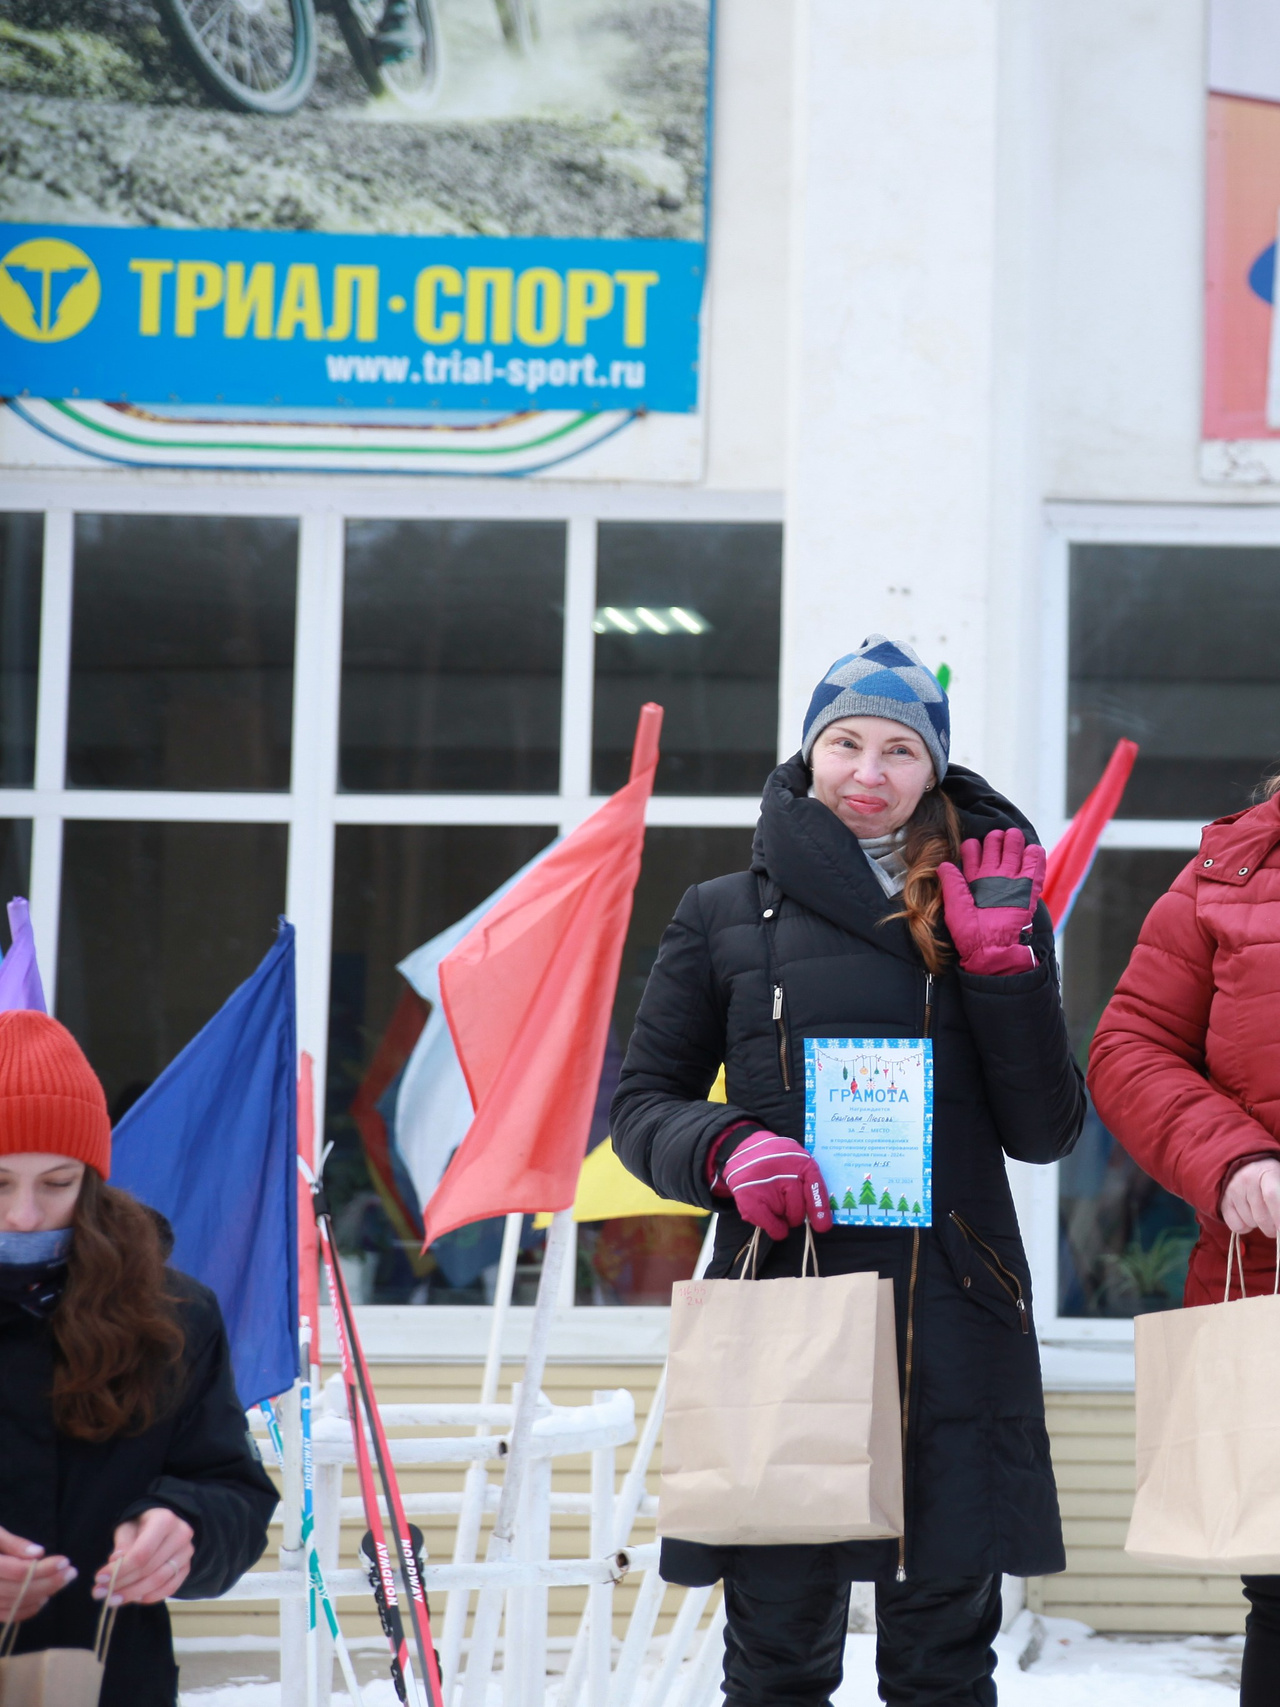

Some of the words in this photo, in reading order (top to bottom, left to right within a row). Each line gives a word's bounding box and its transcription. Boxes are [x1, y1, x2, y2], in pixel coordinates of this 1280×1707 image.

[326, 350, 645, 392] www.trial-sport.ru
[829, 1089, 909, 1102] ГРАМОТА
[302, 1437, 313, 1490] NORDWAY
[375, 1541, 399, 1606] NORDWAY
[400, 1538, 424, 1603] NORDWAY
